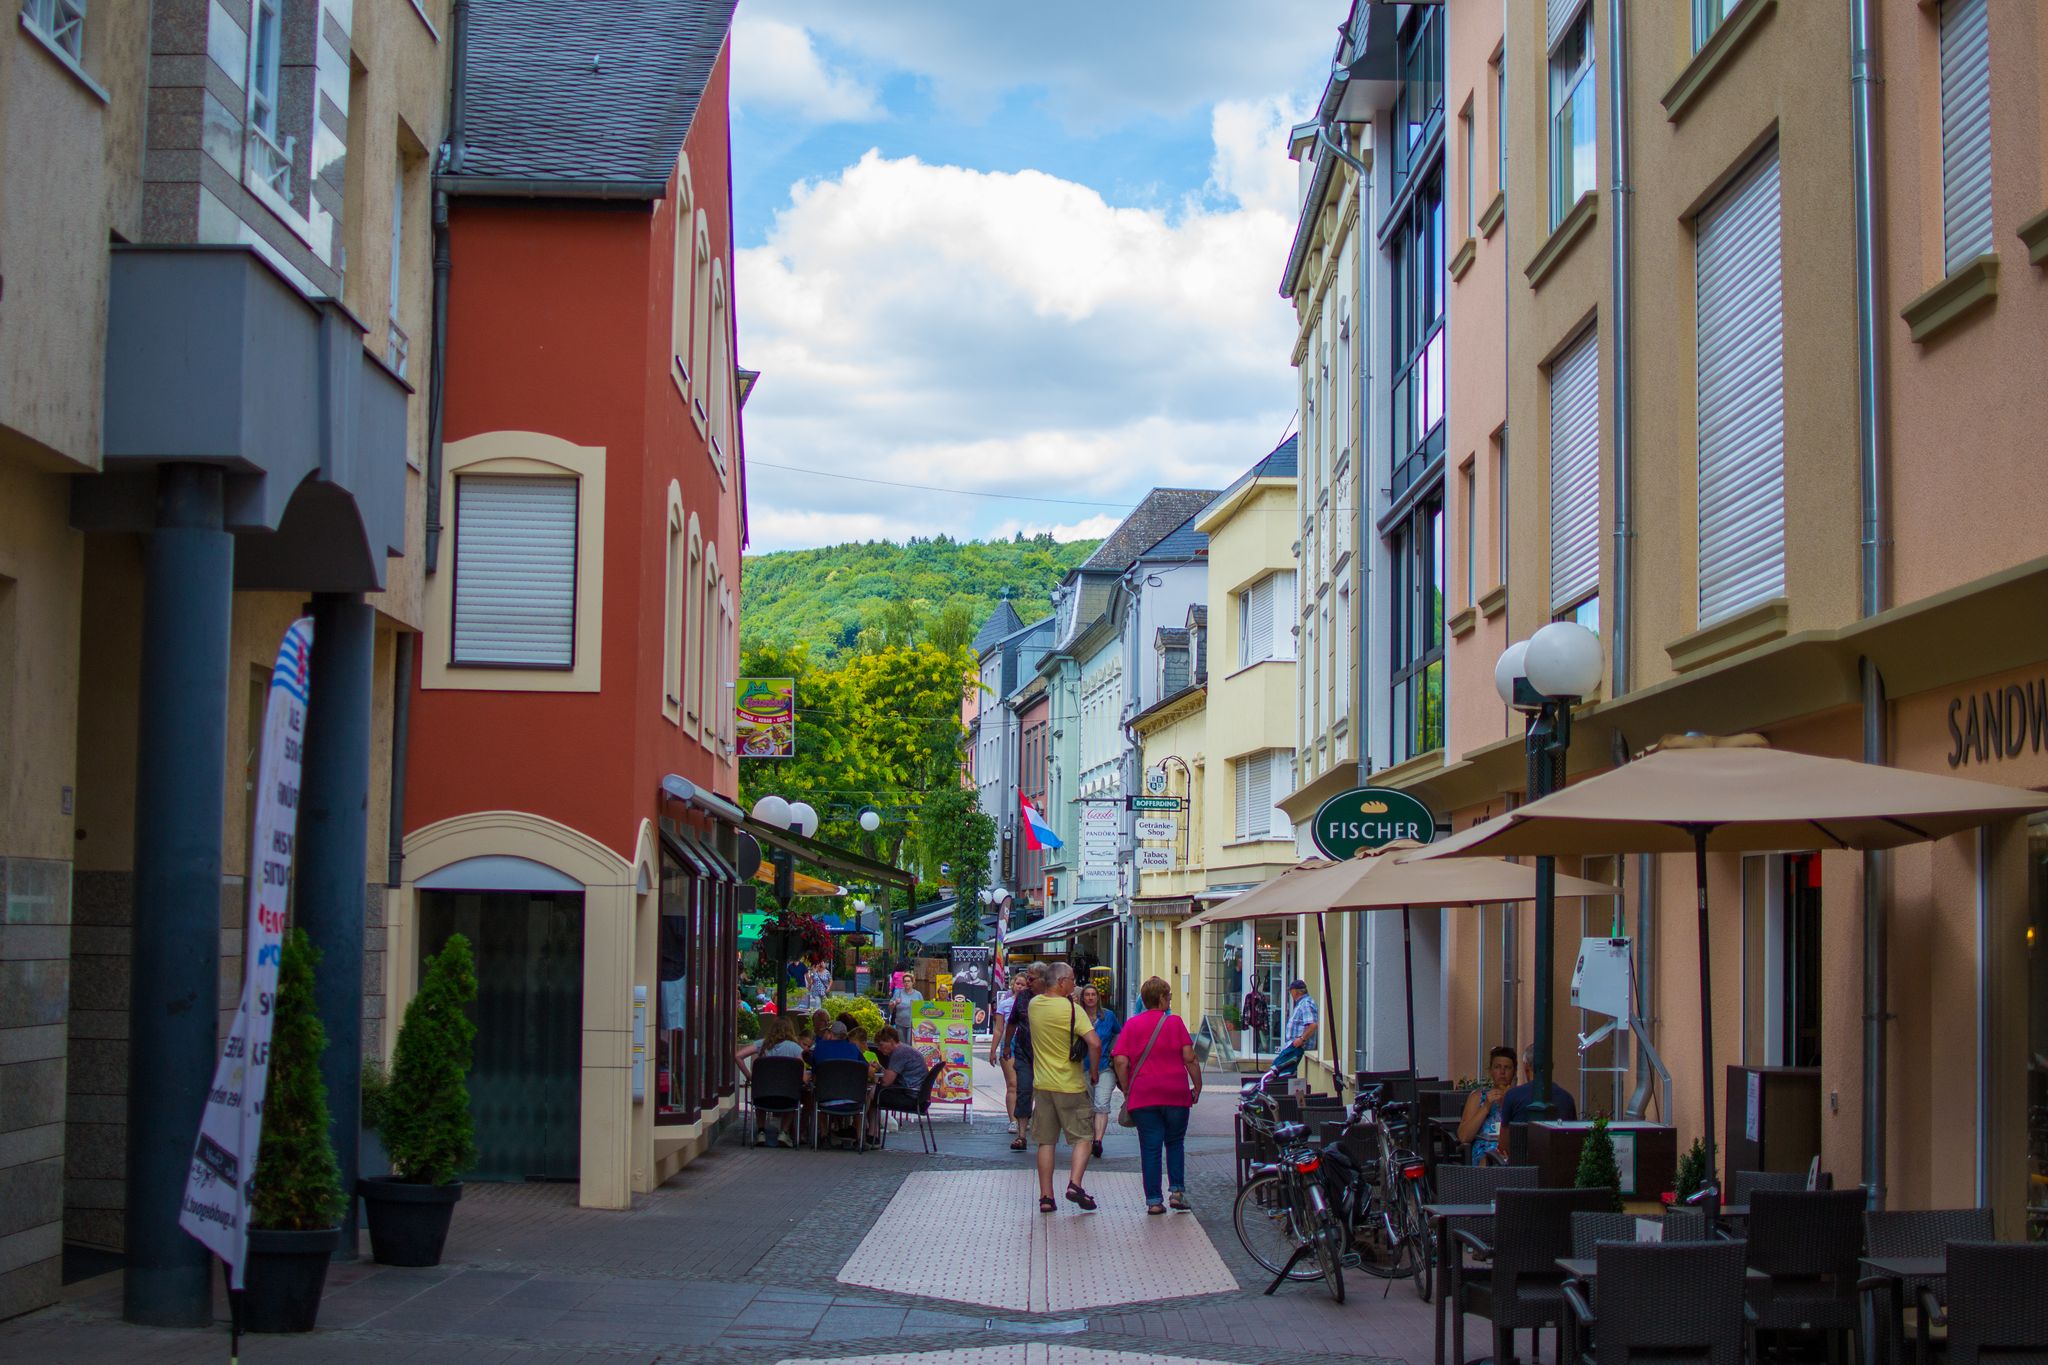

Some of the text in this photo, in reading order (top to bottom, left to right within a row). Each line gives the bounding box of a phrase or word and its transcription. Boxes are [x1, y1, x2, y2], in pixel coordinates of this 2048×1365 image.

[1135, 799, 1177, 808] BOFFERDING
[1138, 821, 1174, 830] Getränke-
[1147, 829, 1165, 837] Shop
[1329, 821, 1420, 840] FISCHER
[1143, 851, 1168, 859] Tabacs
[1085, 869, 1116, 877] SWAROVSKI
